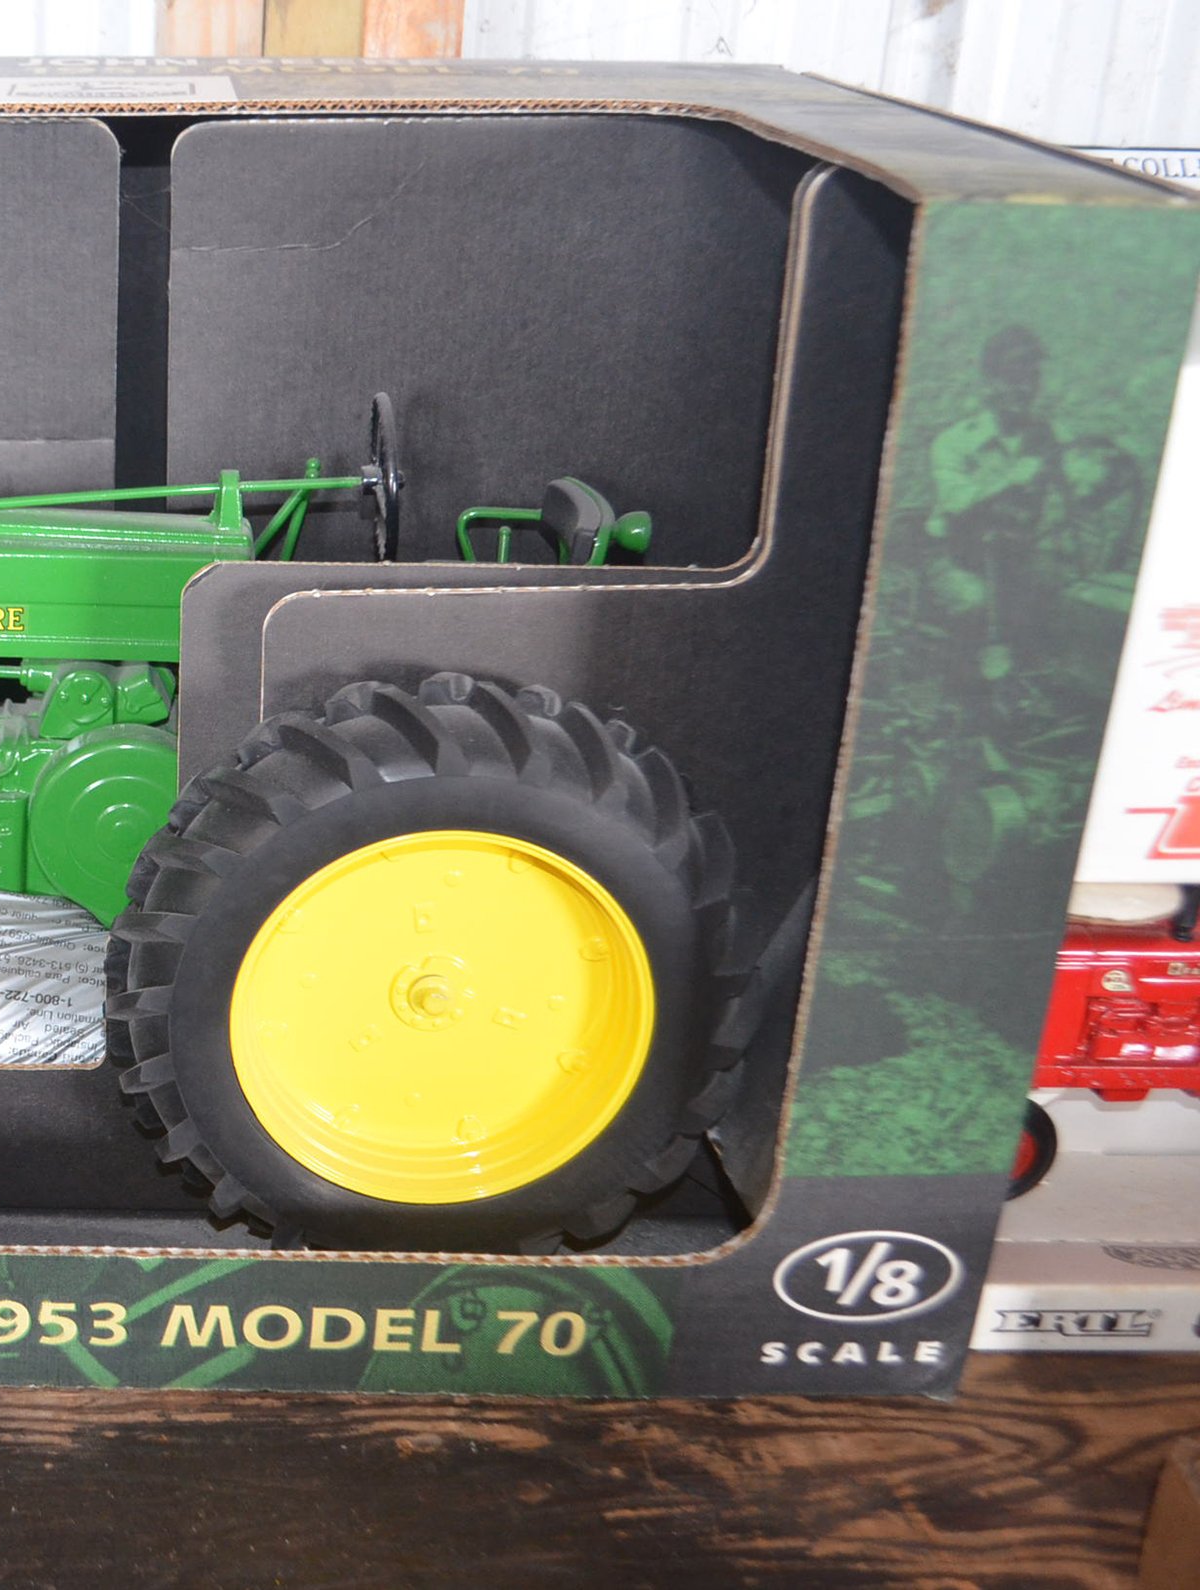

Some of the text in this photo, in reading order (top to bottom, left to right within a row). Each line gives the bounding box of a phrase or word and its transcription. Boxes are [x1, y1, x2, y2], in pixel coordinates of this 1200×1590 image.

[1122, 156, 1200, 178] COLL
[813, 1241, 923, 1306] 1/8
[160, 1304, 462, 1355] MODEL
[497, 1309, 588, 1357] 70
[990, 1309, 1153, 1338] ERTL
[759, 1340, 945, 1365] SCALE
